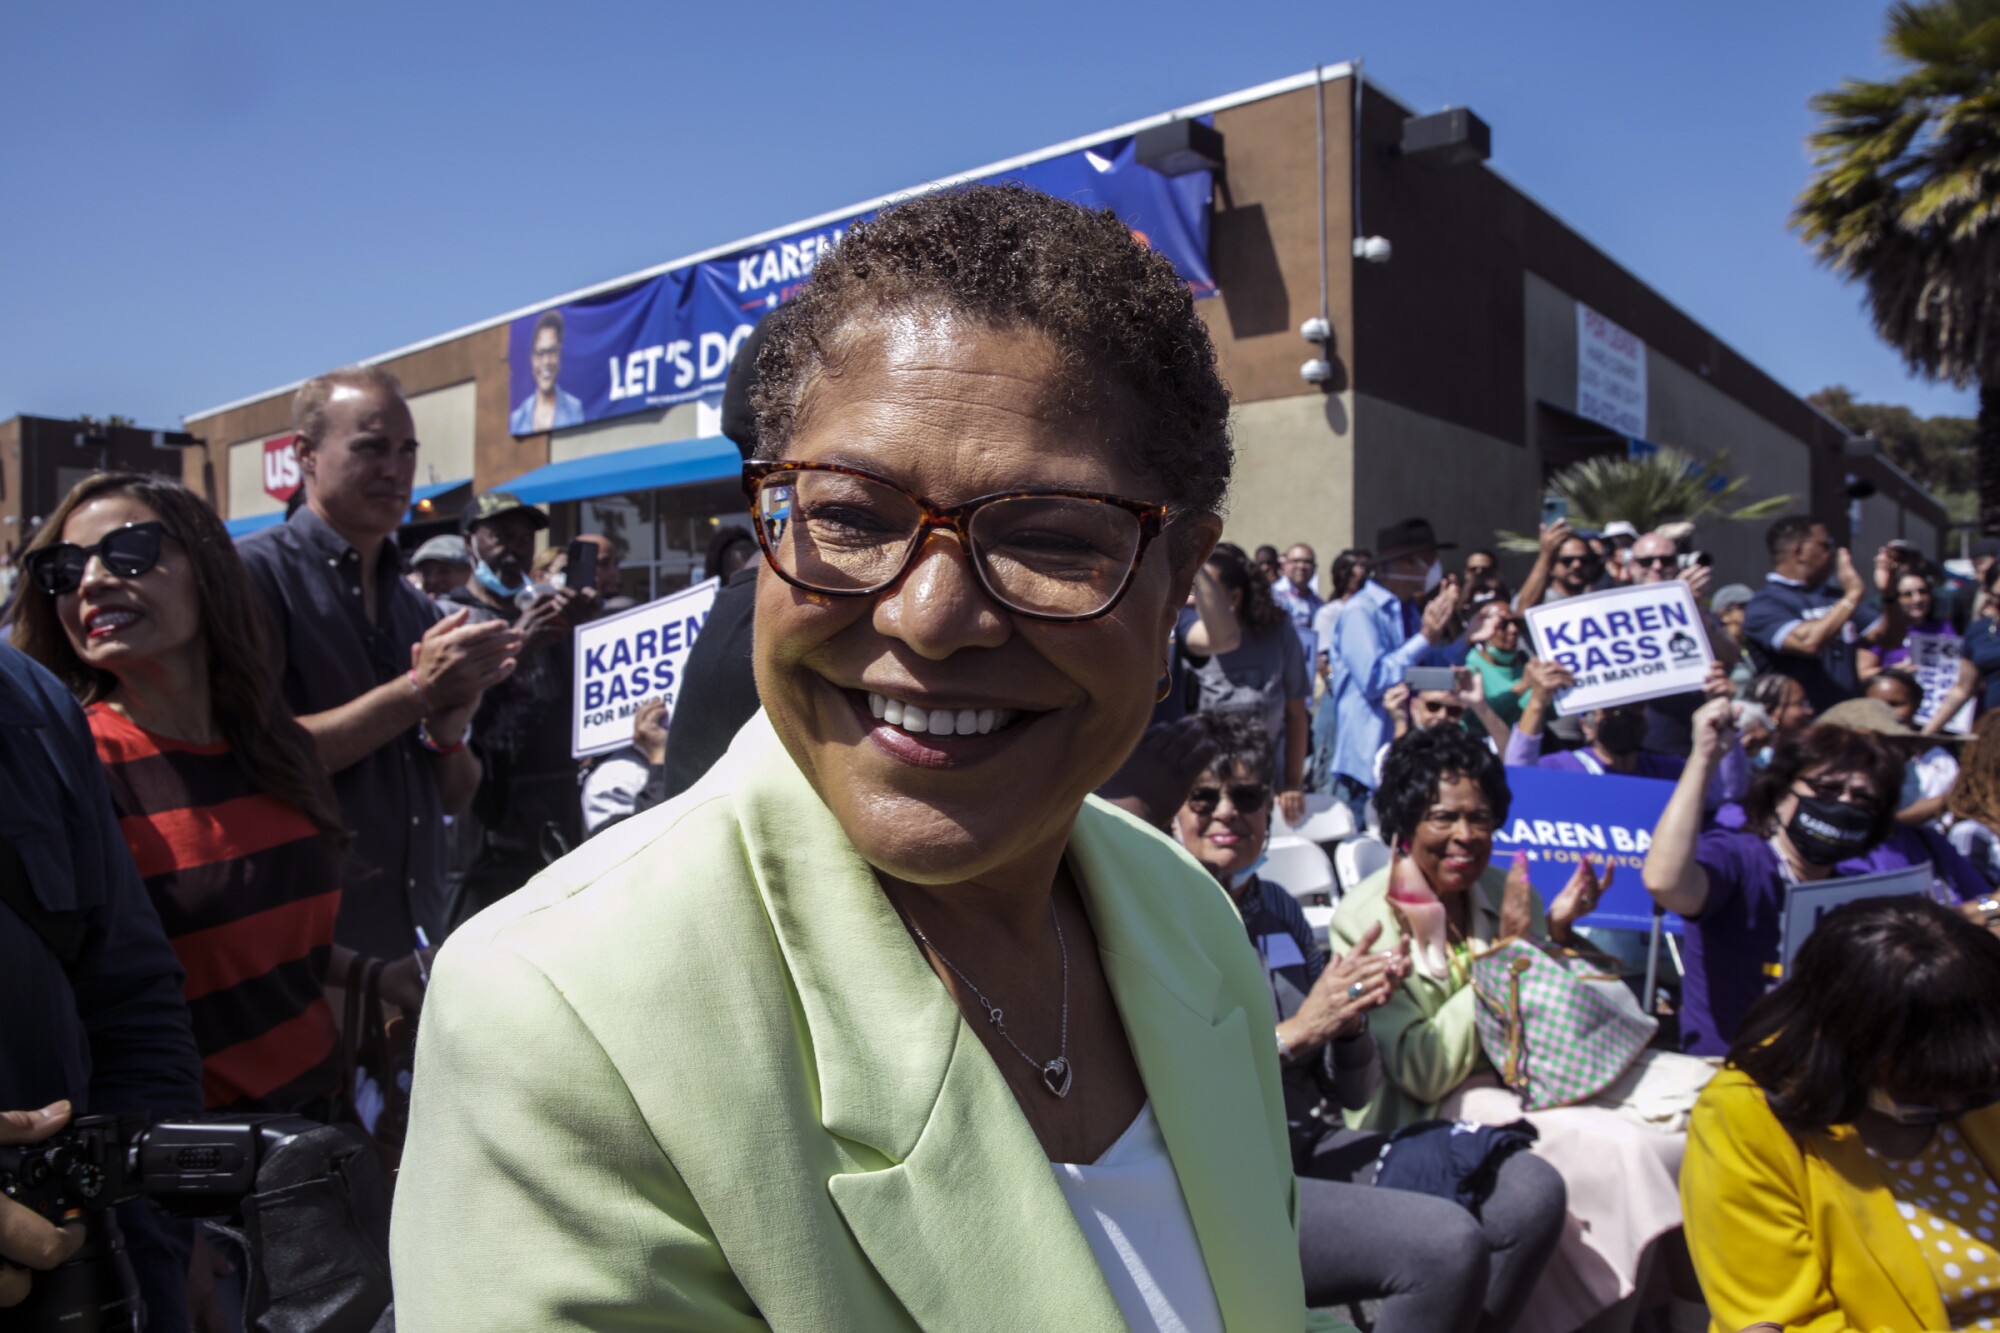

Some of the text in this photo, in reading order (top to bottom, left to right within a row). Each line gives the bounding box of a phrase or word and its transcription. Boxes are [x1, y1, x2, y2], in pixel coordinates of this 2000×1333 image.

[609, 339, 695, 402] LET'S
[585, 611, 710, 679] KAREN
[1544, 601, 1689, 650] KAREN
[1553, 635, 1662, 674] BASS
[1573, 675, 1600, 689] OR
[1603, 660, 1667, 684] MAYOR
[584, 659, 674, 712] BASS
[584, 709, 614, 729] FOR
[1543, 849, 1580, 864] FOR
